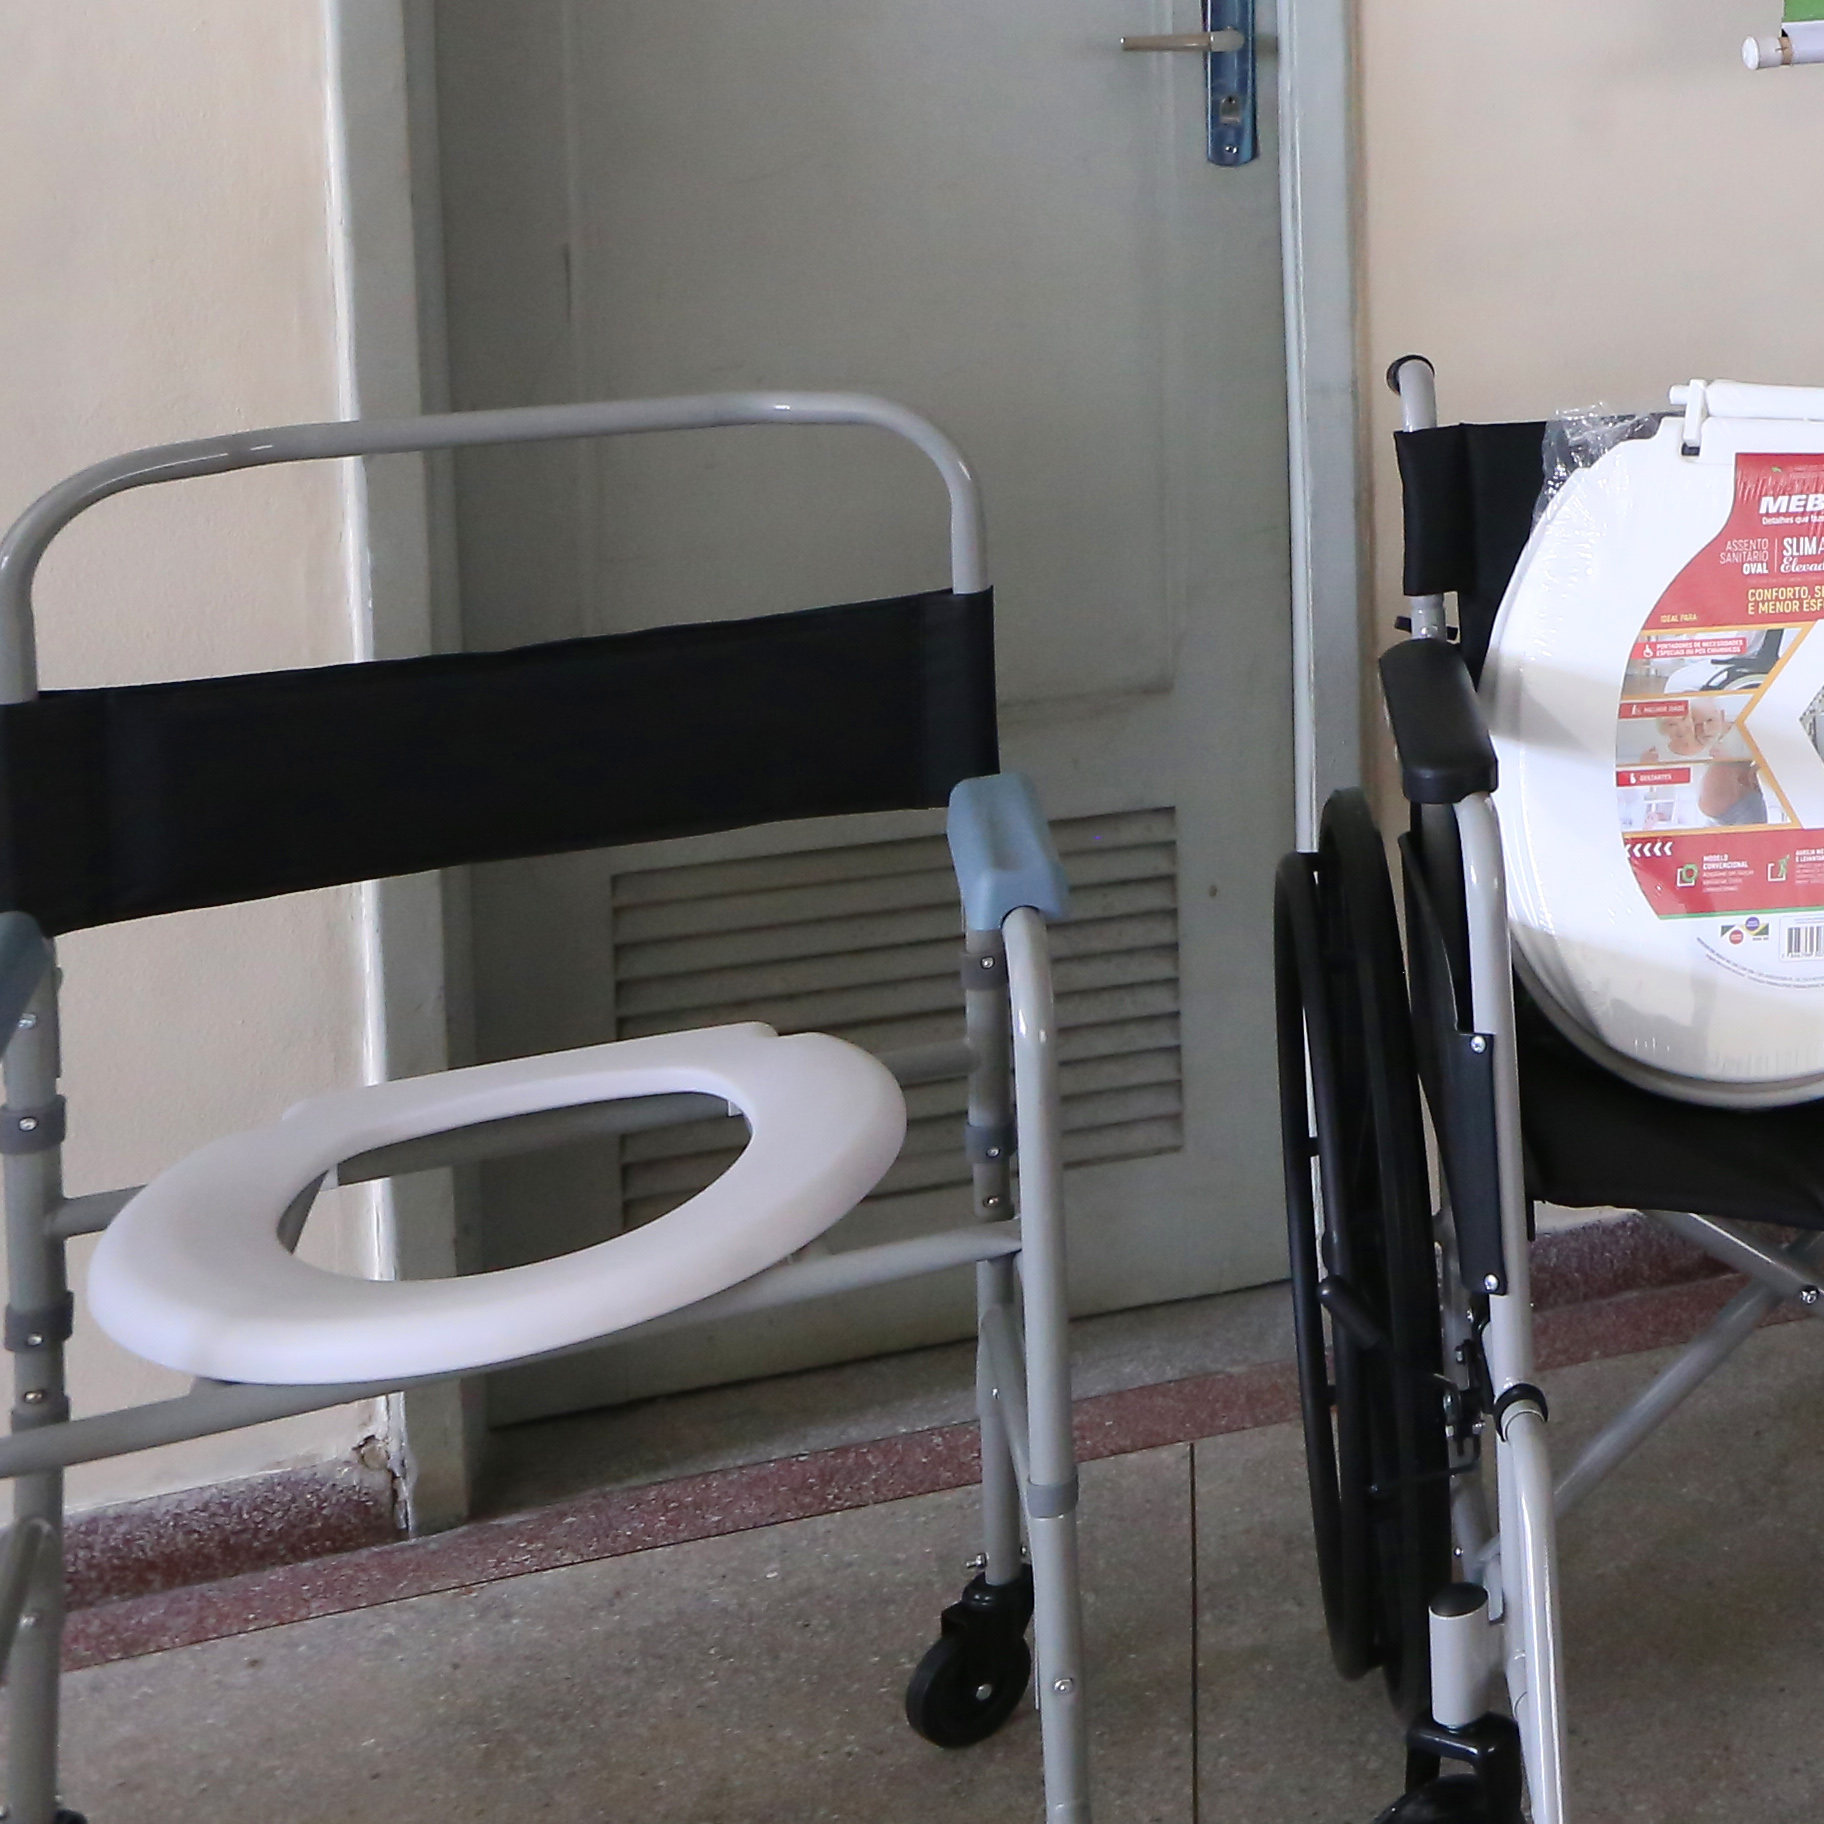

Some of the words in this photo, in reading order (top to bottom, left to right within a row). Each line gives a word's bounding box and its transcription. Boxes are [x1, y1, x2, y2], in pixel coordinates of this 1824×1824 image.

[1725, 538, 1769, 551] ASSENTO
[1742, 562, 1769, 575] OVAL
[1748, 586, 1812, 601] CONFORTO,
[1748, 602, 1755, 614] E
[1758, 600, 1799, 614] MENOR
